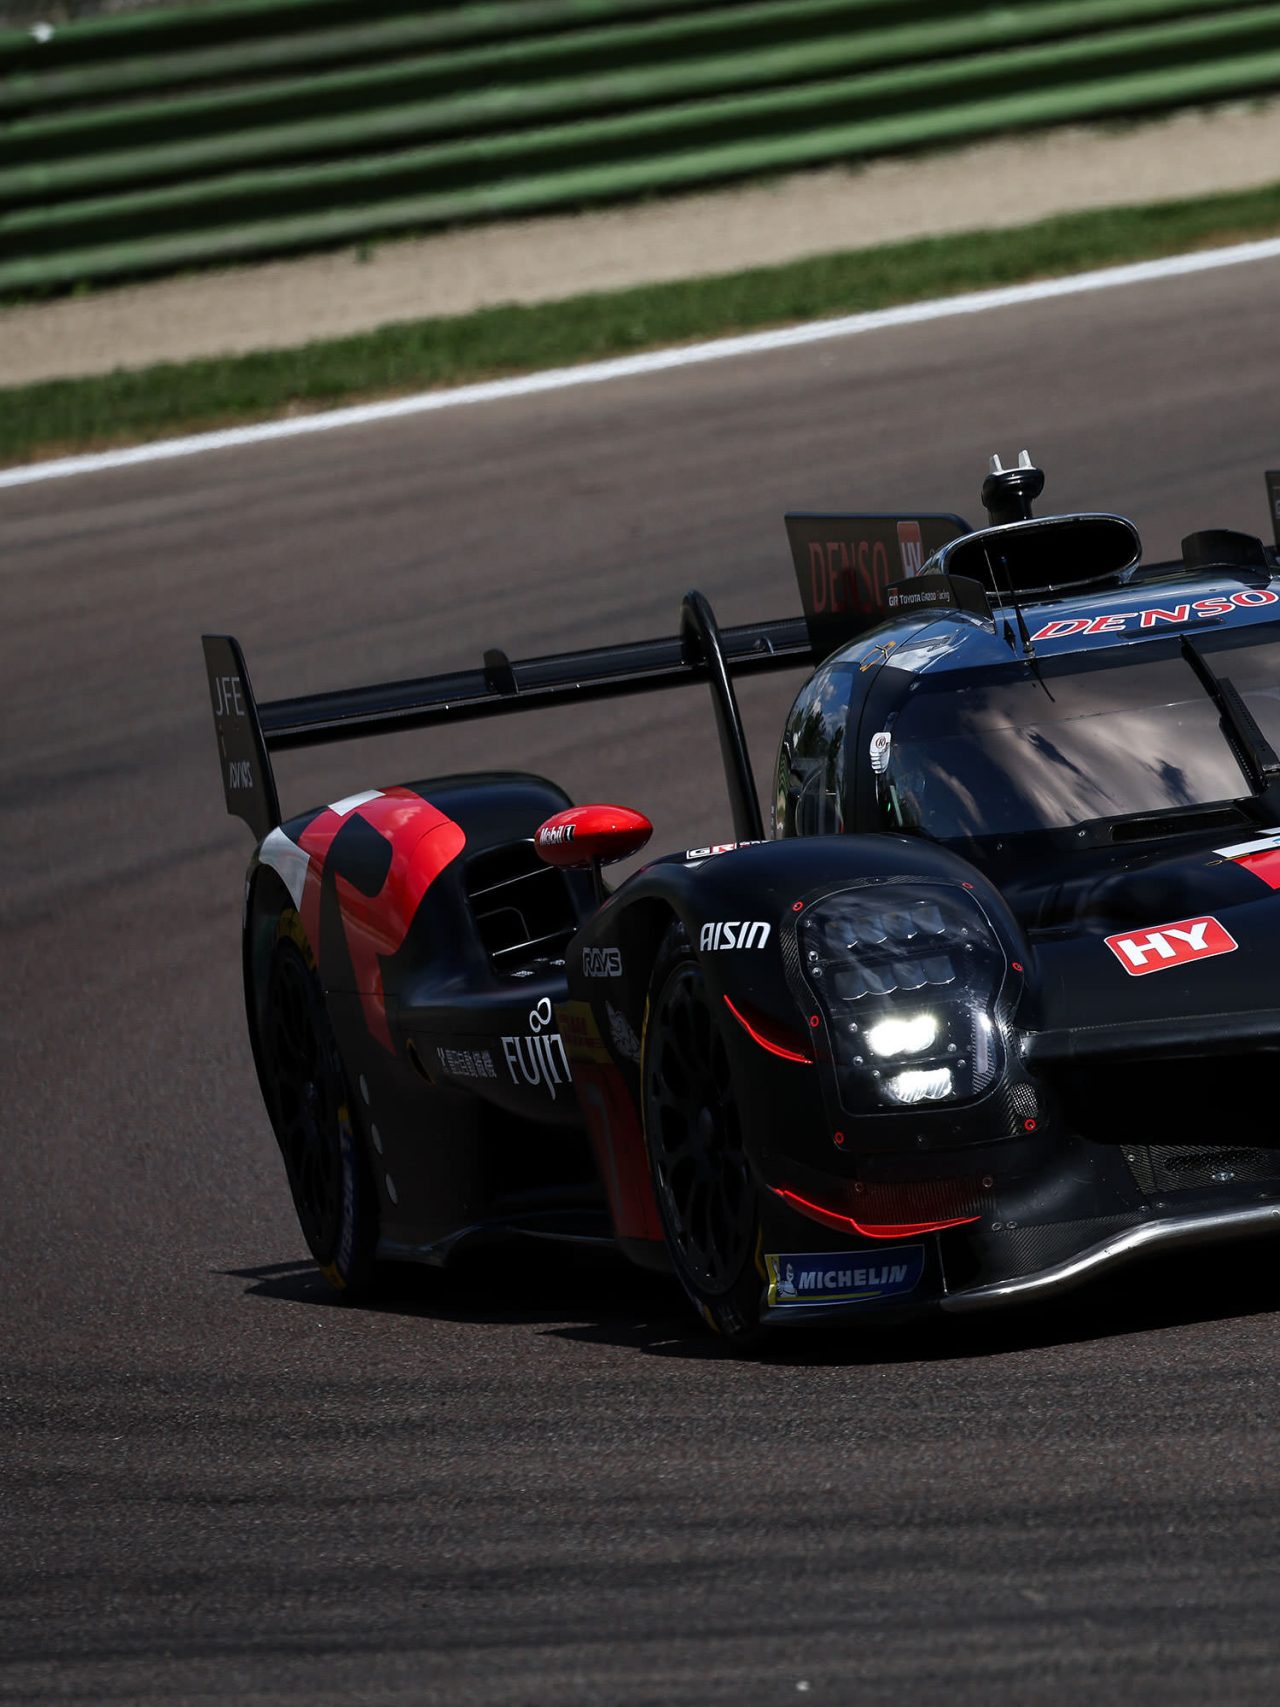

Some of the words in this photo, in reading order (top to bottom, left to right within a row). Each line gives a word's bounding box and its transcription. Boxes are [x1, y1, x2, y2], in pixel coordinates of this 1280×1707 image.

[808, 540, 890, 614] DENSO
[1030, 589, 1279, 641] DENSO
[216, 677, 245, 716] JFE
[540, 825, 565, 845] Mobil
[700, 921, 771, 951] AISIN
[1116, 922, 1208, 967] HY
[583, 947, 623, 977] RAYS
[501, 1033, 573, 1101] FUJIT
[798, 1265, 908, 1290] MICHELIN
